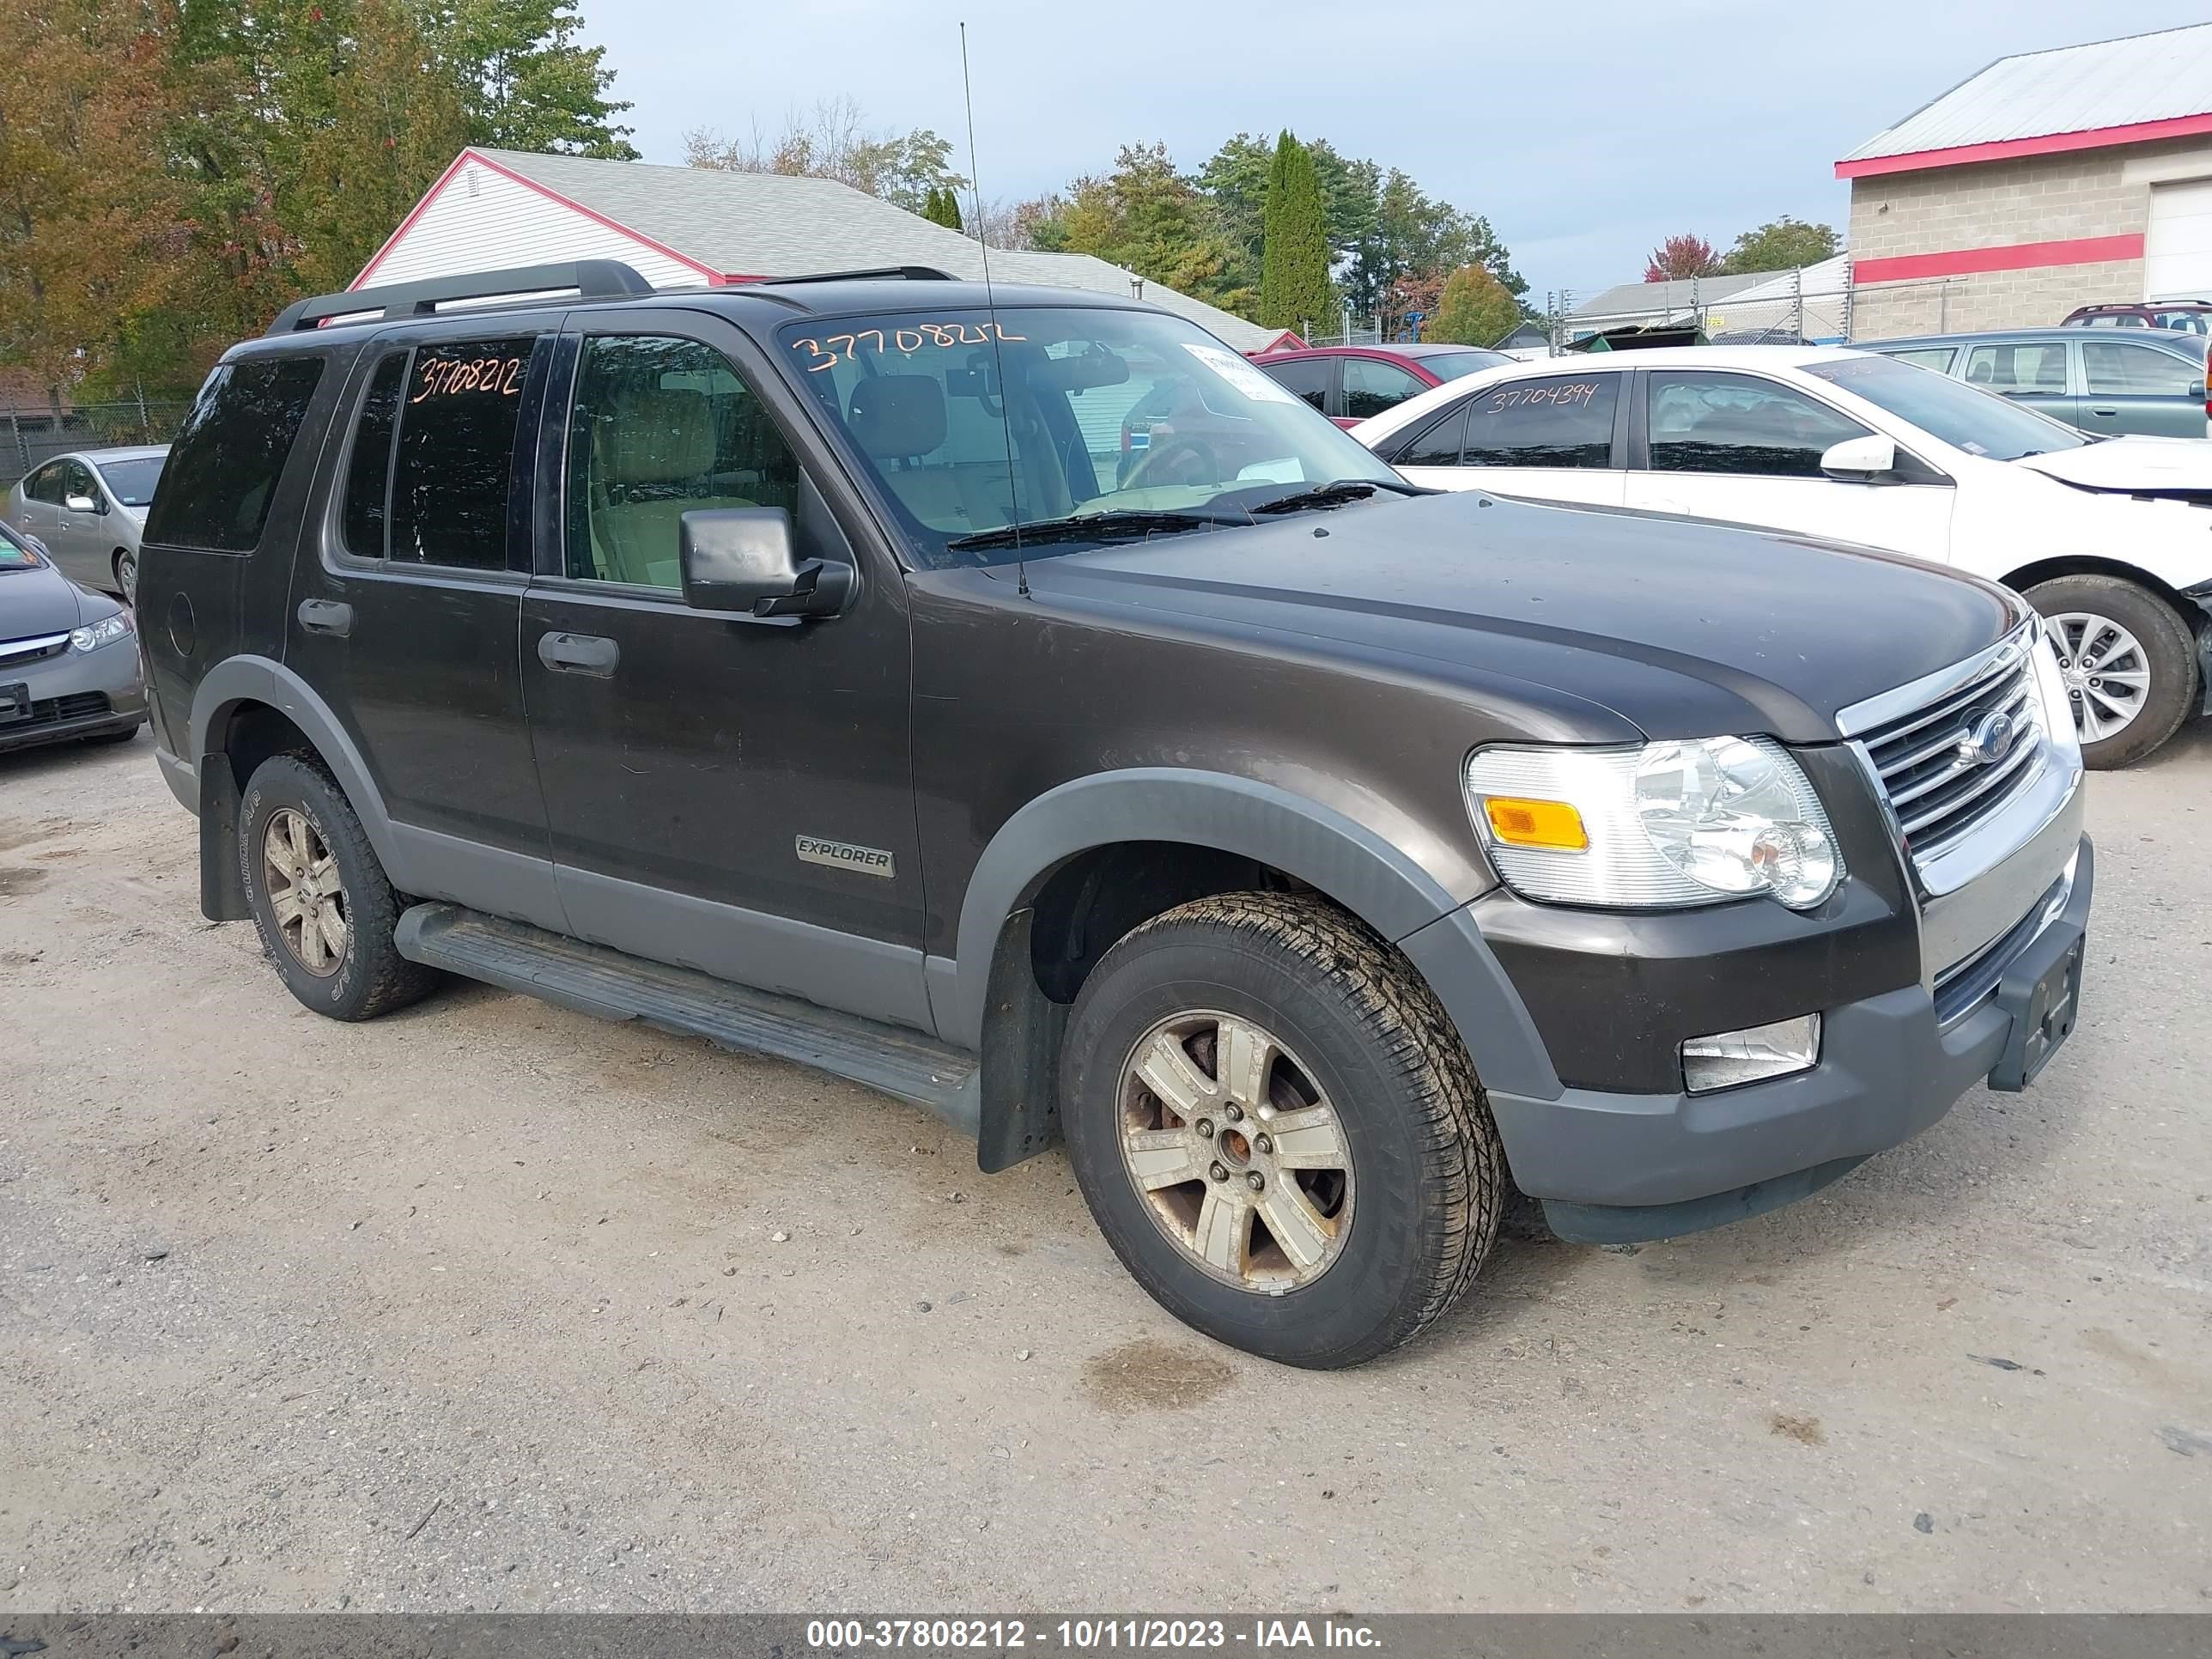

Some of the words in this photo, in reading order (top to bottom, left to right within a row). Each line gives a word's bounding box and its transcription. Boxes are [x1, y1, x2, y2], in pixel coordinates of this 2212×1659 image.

[792, 323, 1028, 373] 37708212
[412, 357, 520, 404] 37708212
[1486, 383, 1599, 415] 37704394
[1992, 721, 2011, 753] Ford
[240, 833, 254, 902] GUIDE
[799, 839, 890, 867] EXPLORER
[341, 885, 356, 963] GUIDE
